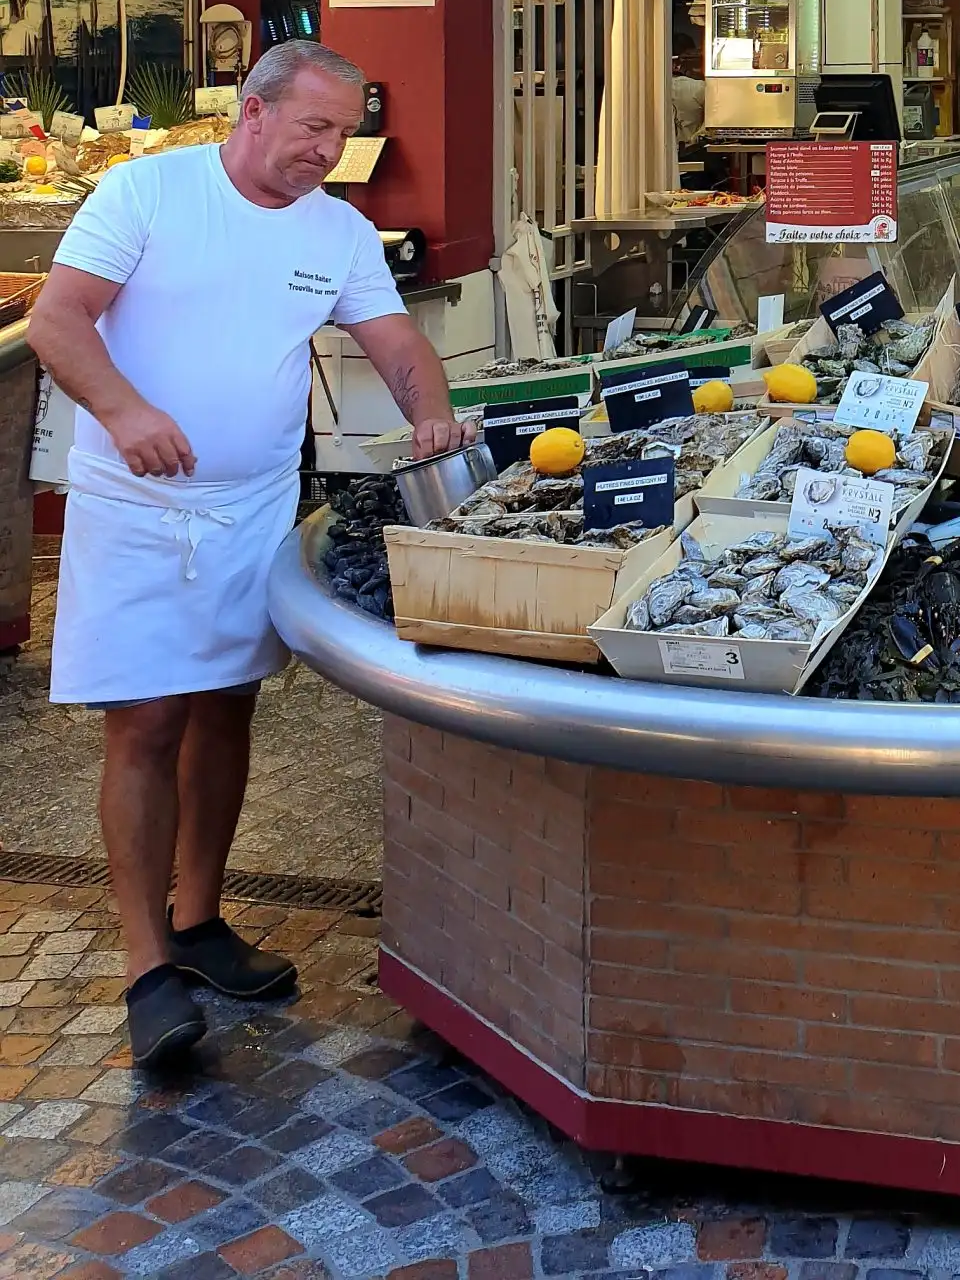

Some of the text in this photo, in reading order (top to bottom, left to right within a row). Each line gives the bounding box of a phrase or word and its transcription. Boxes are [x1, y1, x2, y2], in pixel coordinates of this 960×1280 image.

[779, 228, 808, 240] Faites
[809, 231, 833, 239] votre
[835, 228, 861, 240] choix
[294, 270, 314, 281] Maison
[841, 487, 884, 503] KRYSTALE
[725, 651, 740, 665] 3
